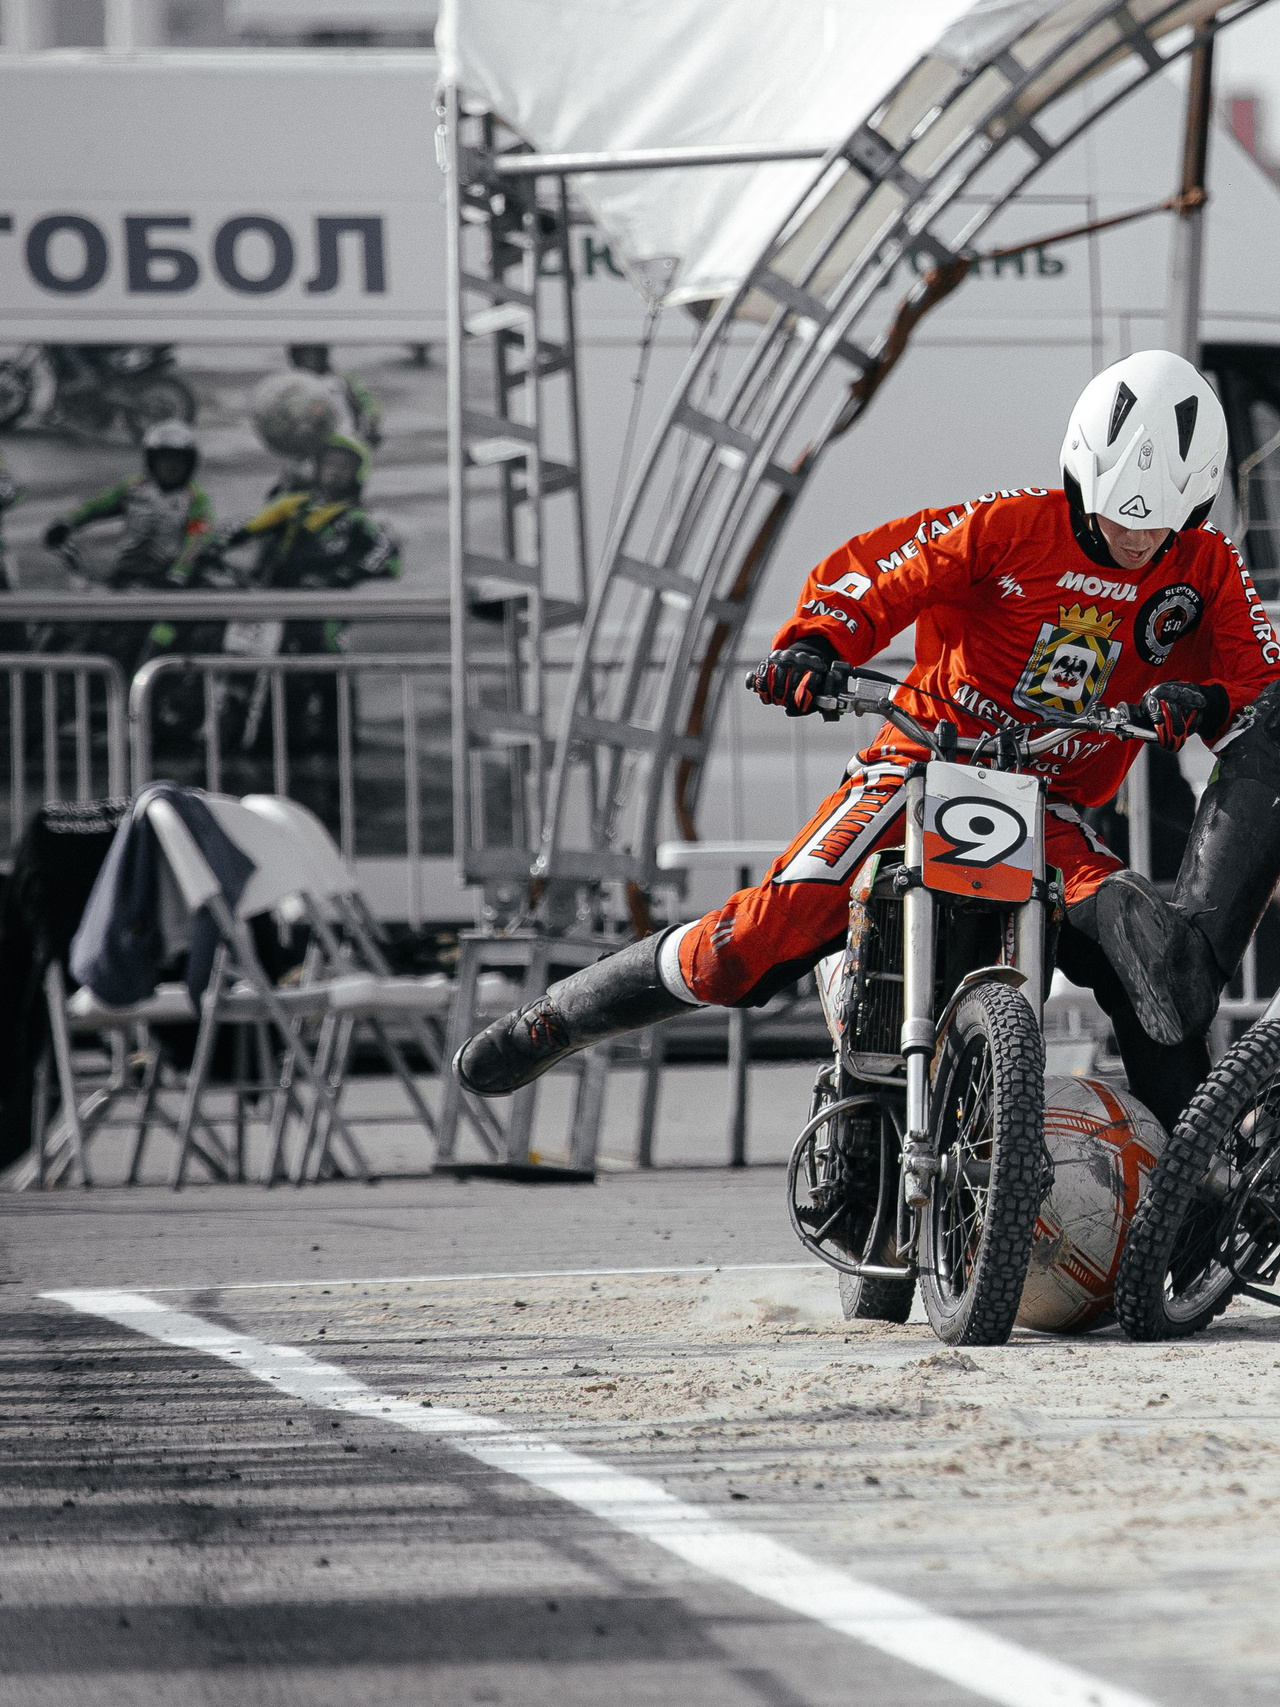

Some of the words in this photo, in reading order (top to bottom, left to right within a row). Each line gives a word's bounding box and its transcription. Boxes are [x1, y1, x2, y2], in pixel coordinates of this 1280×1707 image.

[0, 214, 387, 294] ОБОЛ
[1055, 570, 1139, 603] MOTUL
[928, 795, 1028, 869] 9
